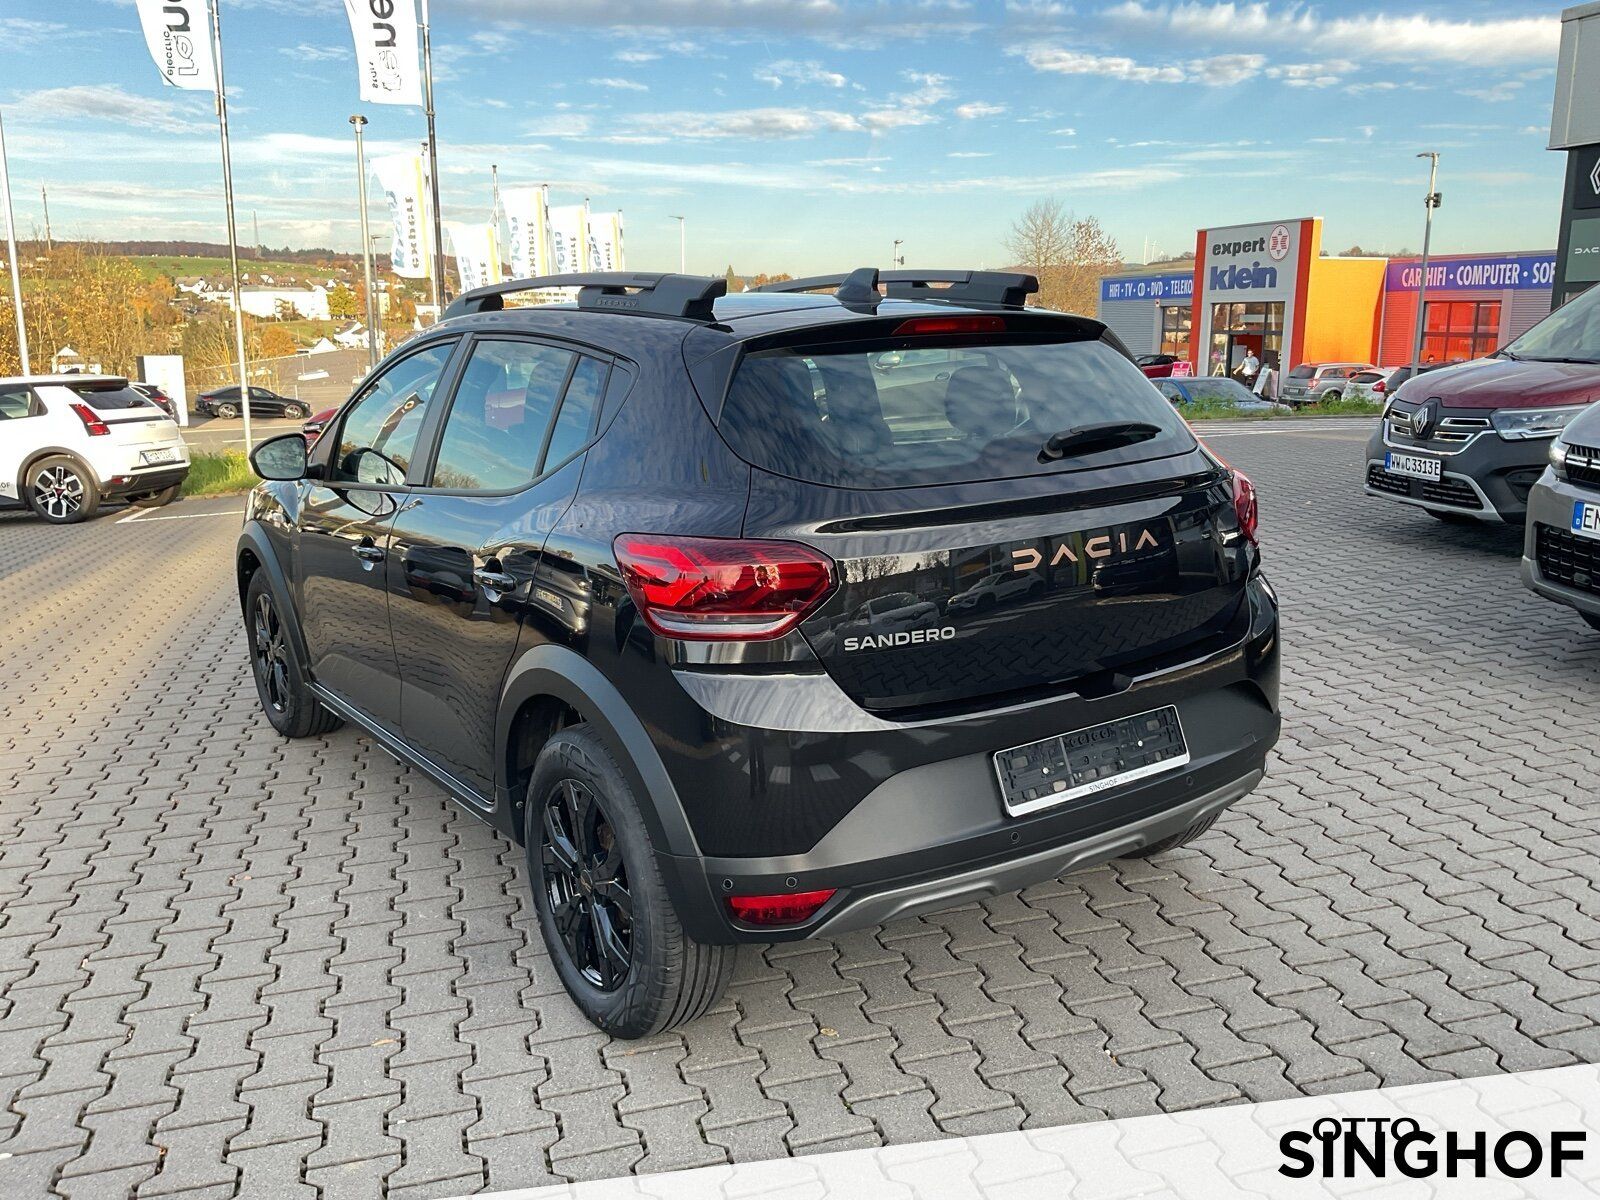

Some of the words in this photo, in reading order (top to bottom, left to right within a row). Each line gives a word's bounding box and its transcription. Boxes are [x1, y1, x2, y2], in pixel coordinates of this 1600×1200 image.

[1212, 237, 1265, 256] expert
[1209, 261, 1277, 290] klein
[1401, 268, 1421, 287] CAR
[1425, 267, 1447, 287] HIFI
[1456, 264, 1520, 285] COMPUTER
[1109, 284, 1120, 297] HIFI
[1125, 283, 1133, 296] TV
[1137, 282, 1145, 297] CD
[1150, 281, 1163, 295] DVD
[1012, 528, 1159, 572] DACIA
[843, 626, 957, 651] SANDERO
[1088, 779, 1119, 793] SINGHOF
